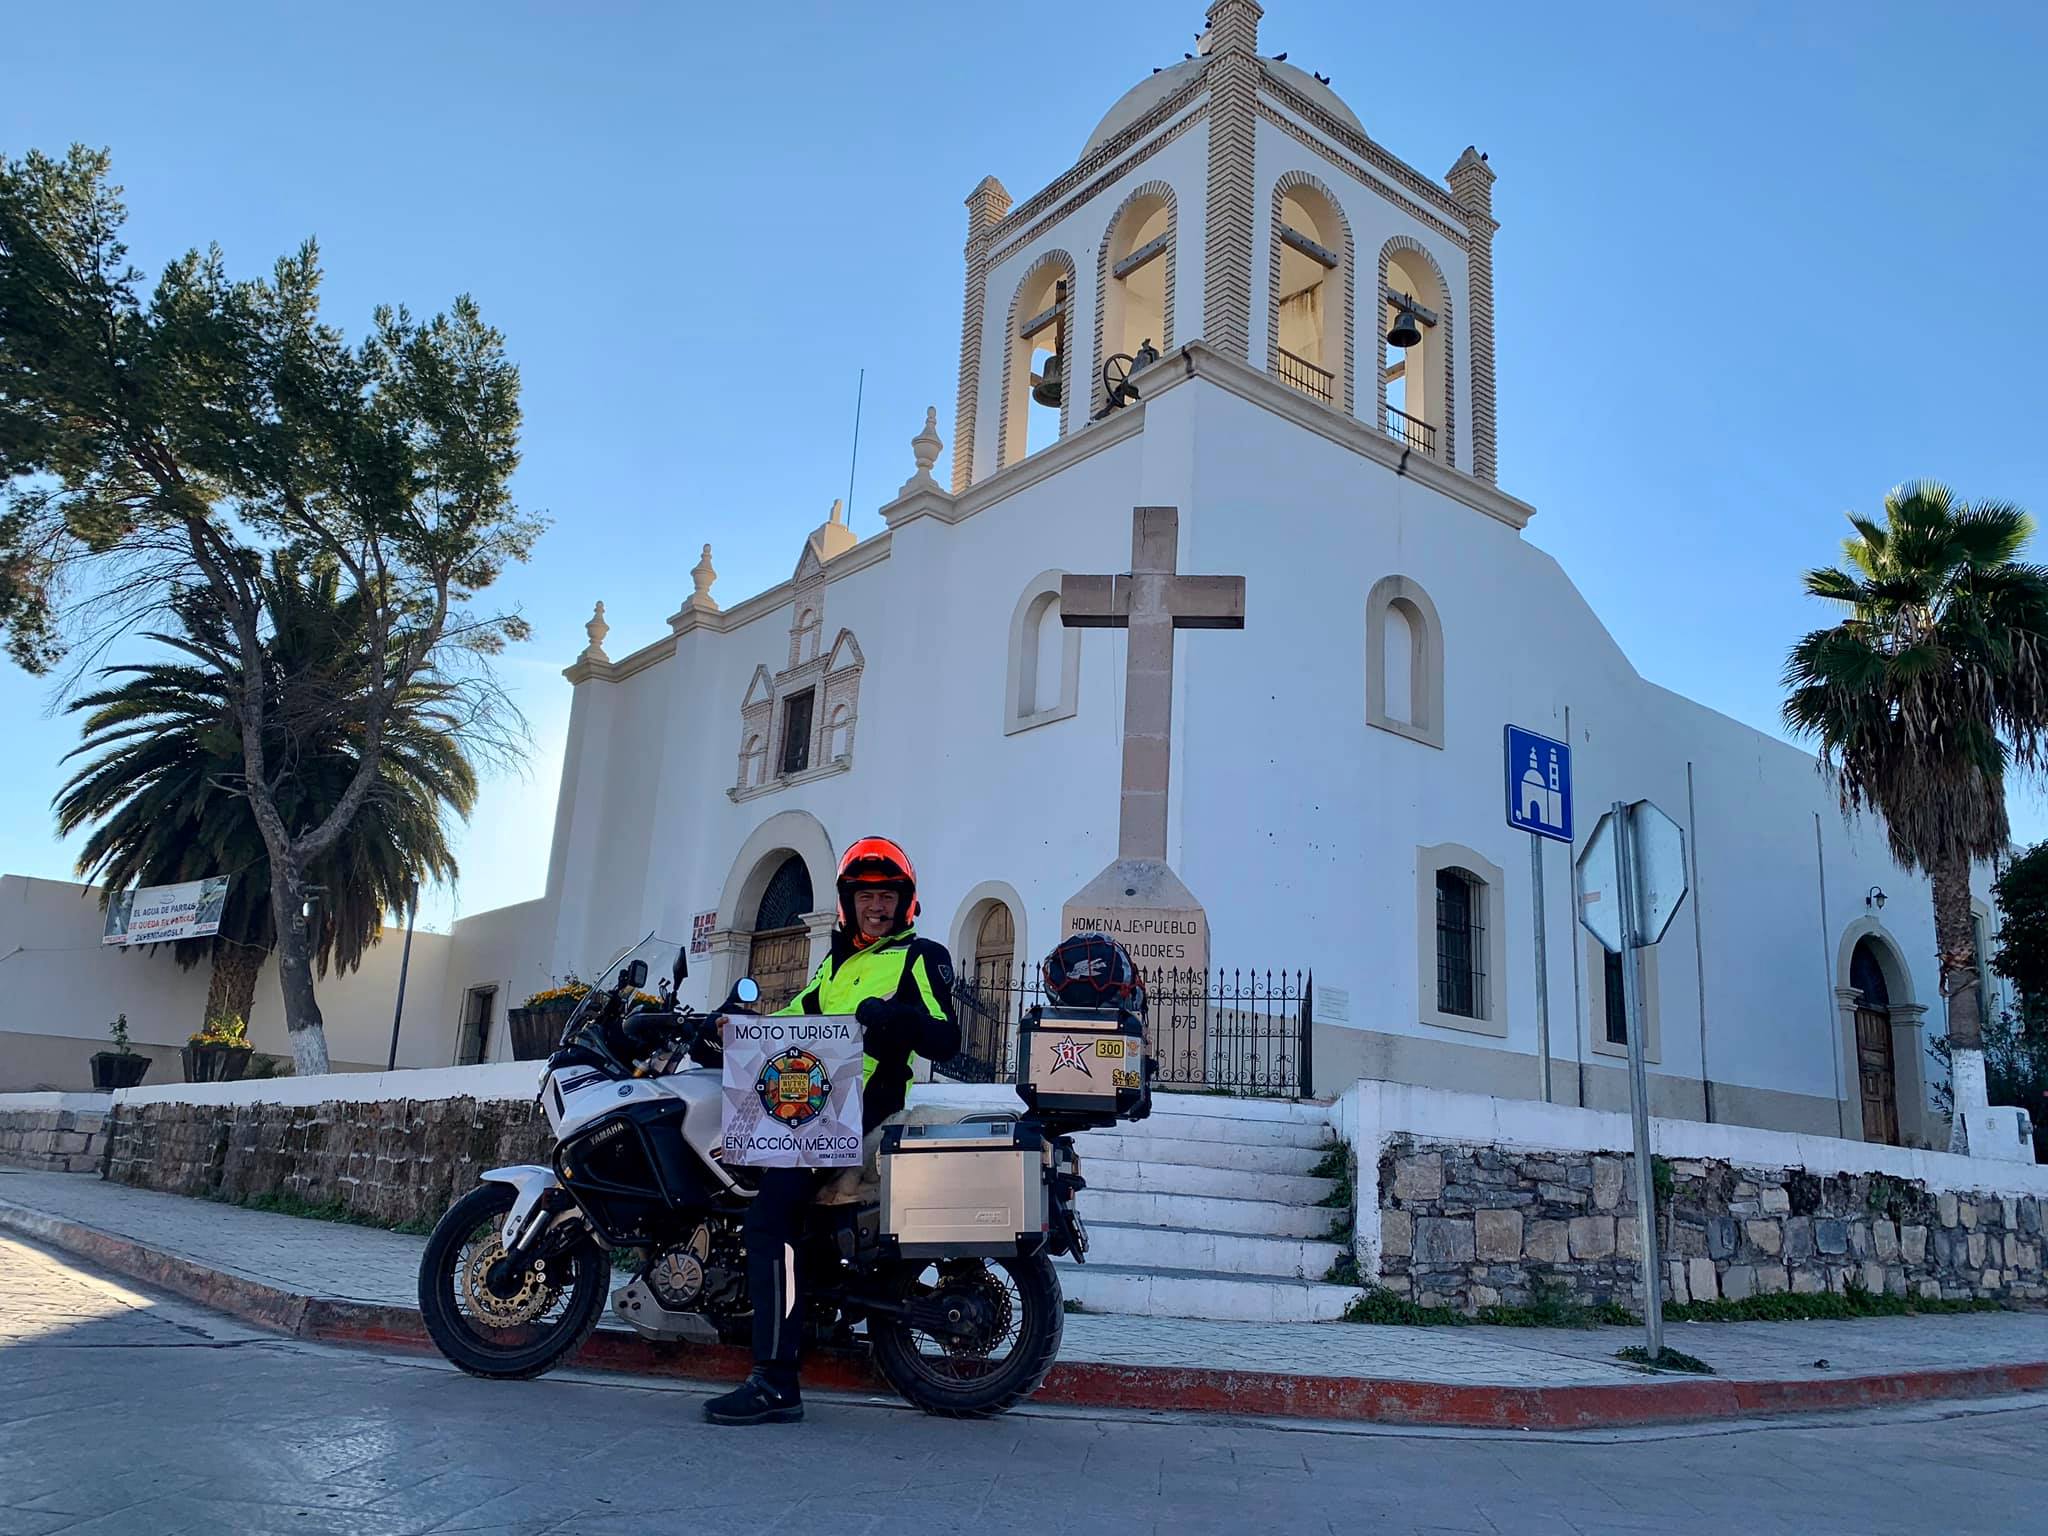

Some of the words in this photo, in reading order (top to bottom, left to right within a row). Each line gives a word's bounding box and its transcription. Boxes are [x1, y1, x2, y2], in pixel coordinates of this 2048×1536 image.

[134, 909, 140, 917] EL
[143, 907, 159, 916] AGUA
[161, 905, 169, 914] DE
[138, 919, 160, 929] QUEDA
[1072, 917, 1140, 933] HOMENAJE
[1145, 920, 1196, 934] PUEBLO
[735, 1025, 785, 1040] MOTO
[788, 1024, 850, 1040] TURISTA
[1099, 1043, 1121, 1055] 300
[589, 1121, 625, 1145] YAMAHA
[725, 1136, 743, 1150] EN
[746, 1134, 802, 1151] ACCIÓN
[805, 1134, 859, 1151] MÉXICO
